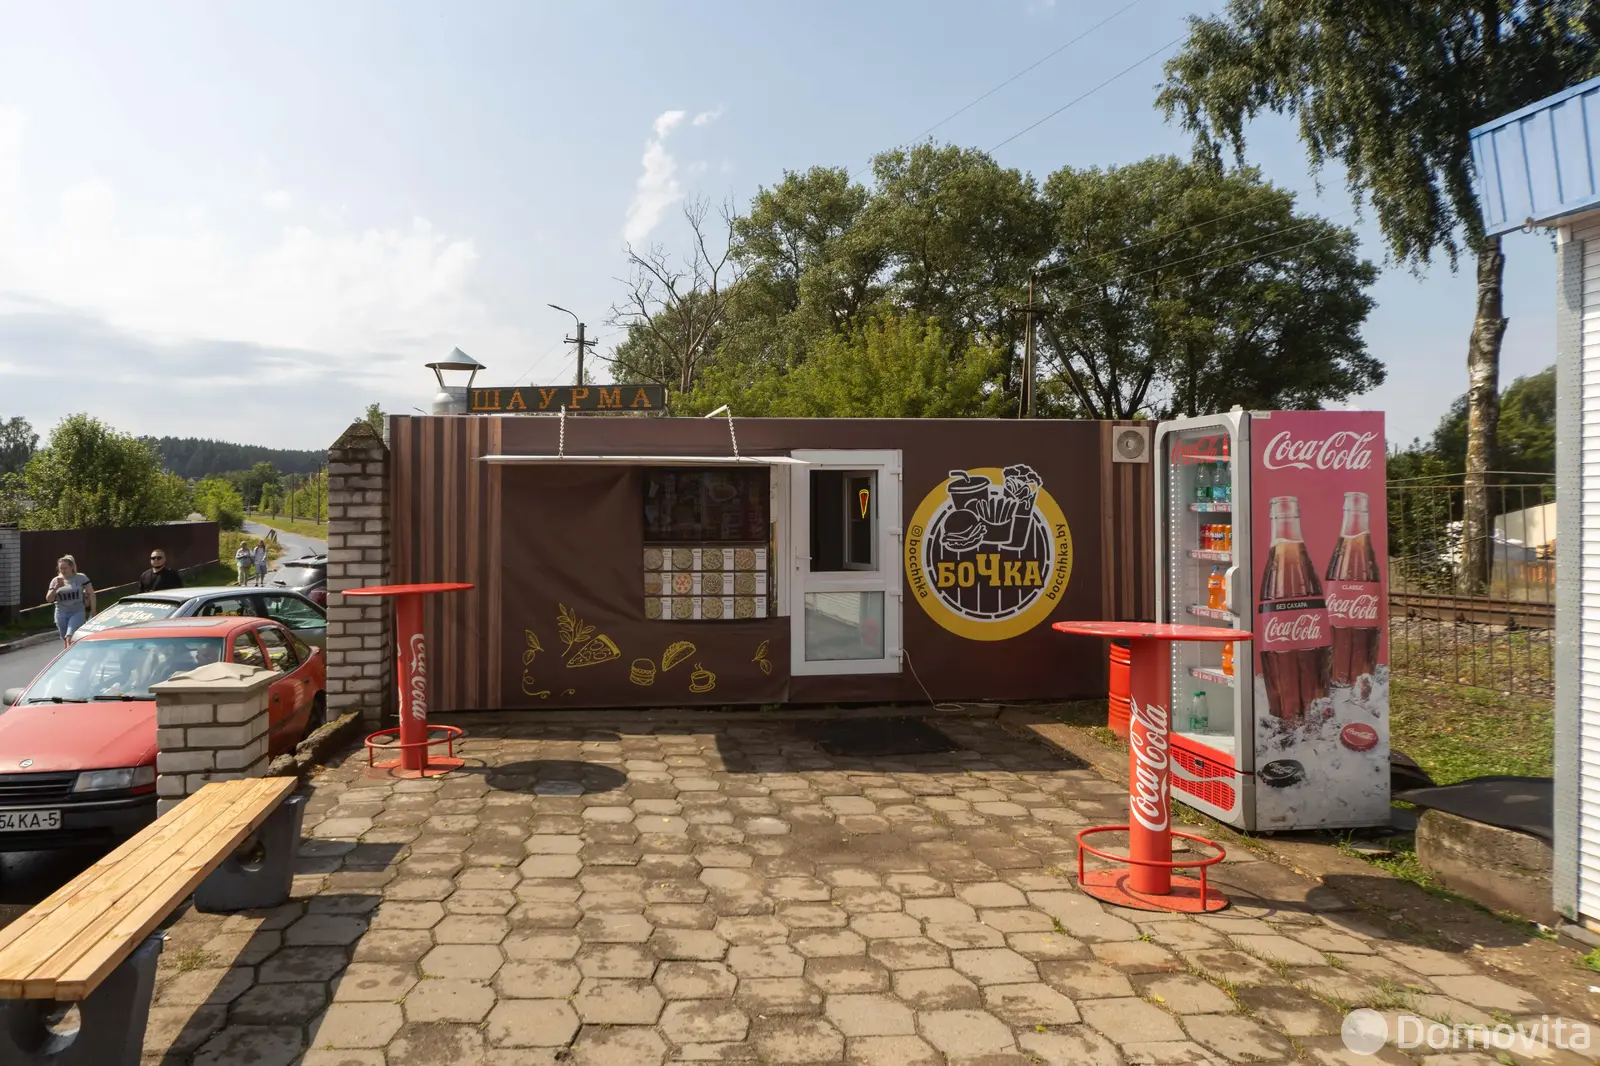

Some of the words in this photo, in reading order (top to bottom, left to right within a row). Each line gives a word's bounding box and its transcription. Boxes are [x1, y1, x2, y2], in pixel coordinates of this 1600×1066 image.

[472, 387, 652, 410] ШАУРМА
[1263, 431, 1379, 470] Coca-Cola
[908, 538, 929, 599] bocchhka
[937, 553, 1043, 588] БОЧКА
[1046, 523, 1068, 600] bocchhka.by
[1276, 602, 1286, 610] БЕЗ
[1325, 593, 1379, 619] Coca-Cola
[1264, 614, 1321, 643] Coca-Cola
[410, 633, 427, 720] CocaCola
[1130, 694, 1168, 832] Coca-Cola
[18, 812, 58, 828] KA-5
